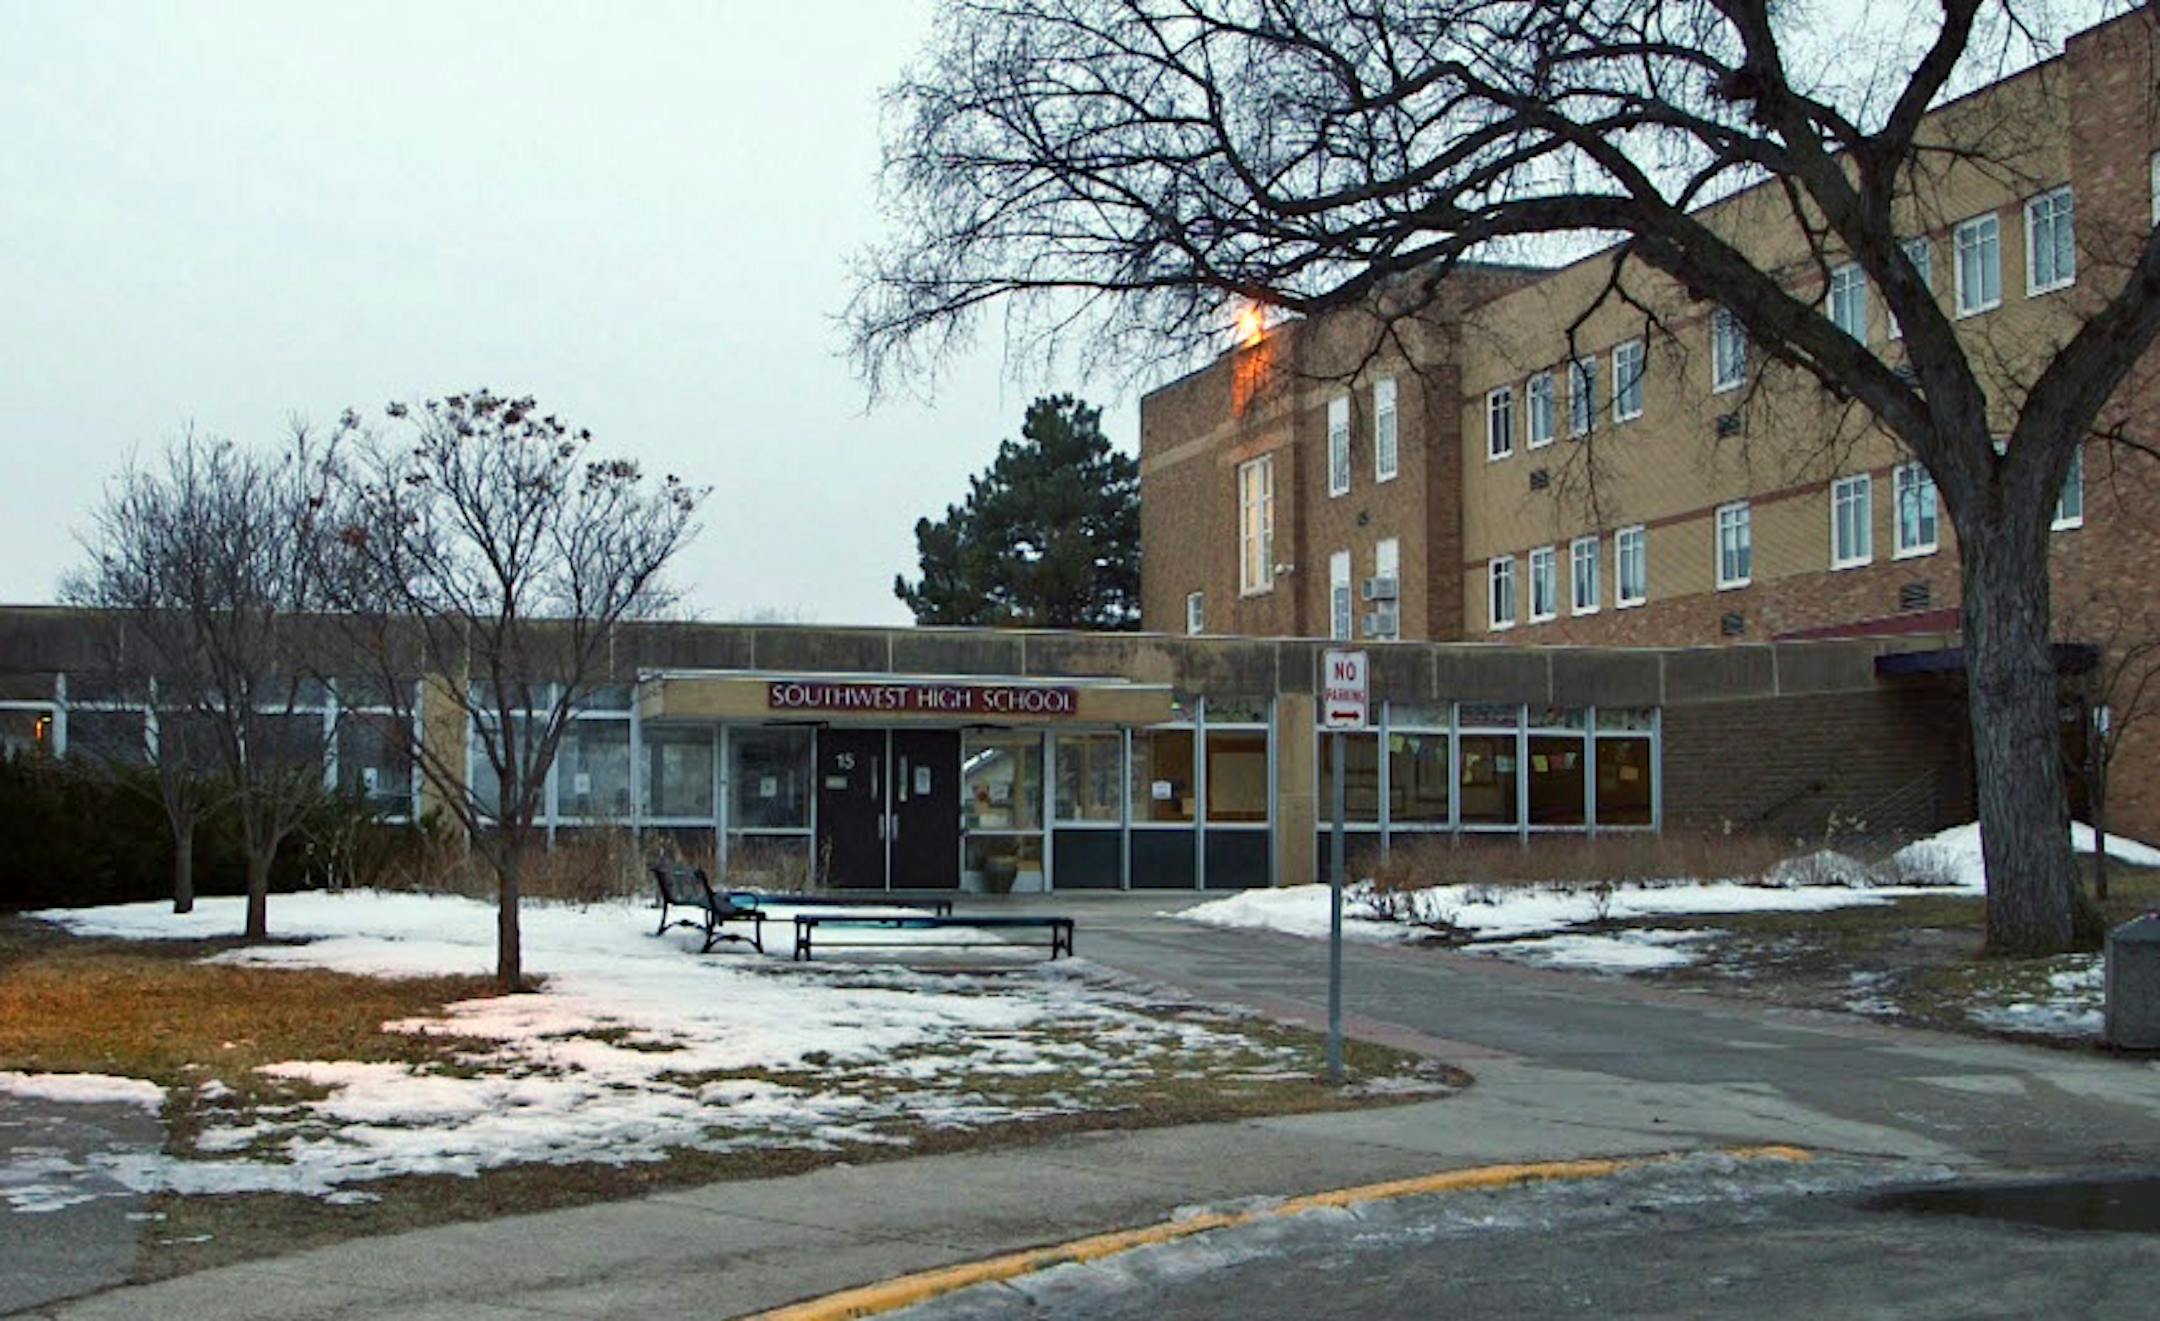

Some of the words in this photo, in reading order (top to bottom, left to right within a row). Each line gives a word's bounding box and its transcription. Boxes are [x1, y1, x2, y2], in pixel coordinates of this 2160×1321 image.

[1334, 661, 1356, 680] NO
[772, 685, 909, 708] SOUTHWEST
[918, 687, 971, 709] HIGH
[982, 690, 1072, 712] SCHOOL
[835, 752, 855, 769] 15
